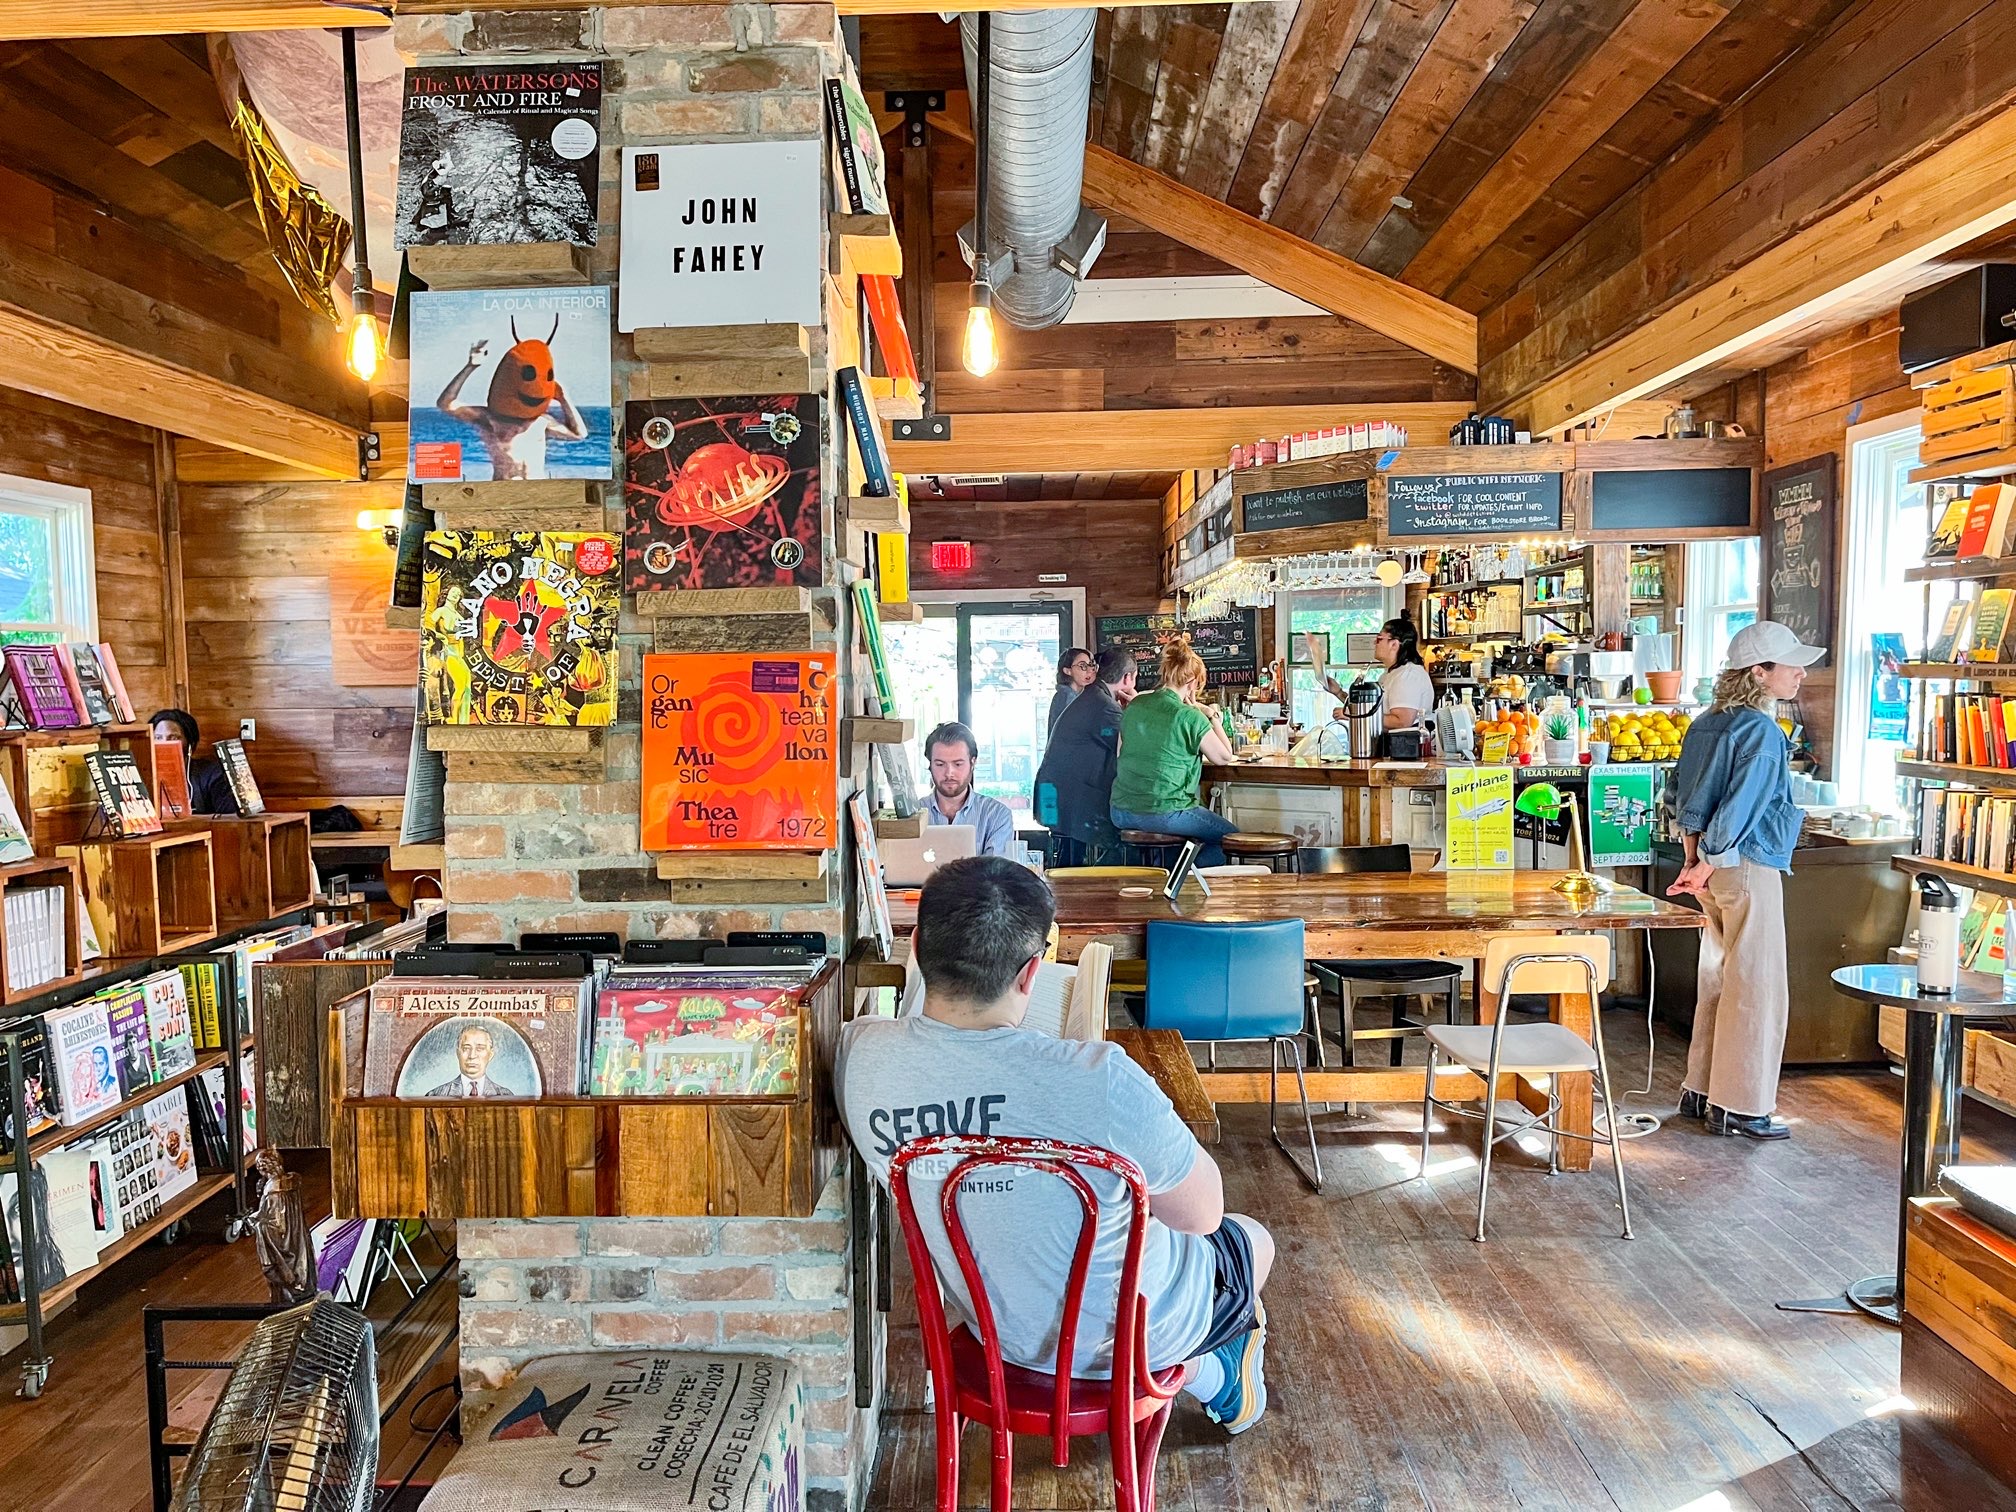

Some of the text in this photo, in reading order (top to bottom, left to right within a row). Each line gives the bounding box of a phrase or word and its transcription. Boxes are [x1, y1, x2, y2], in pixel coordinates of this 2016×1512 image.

[413, 73, 600, 94] The WATERSONS
[408, 92, 563, 110] FROST AND FIRE
[553, 107, 579, 116] Magical
[579, 107, 599, 115] Songs
[835, 100, 848, 141] vulnerables
[843, 147, 853, 167] sigrid
[681, 198, 757, 225] JOHN
[673, 245, 764, 273] FAHEY
[483, 295, 607, 312] LA OLA INTERIOR
[848, 379, 857, 392] THE
[860, 425, 870, 441] MAN
[1444, 477, 1476, 486] PUBLIC
[1477, 476, 1499, 485] WIFI
[1413, 491, 1527, 504] facebook FOR COOL CONTENT
[1414, 502, 1454, 511] twitter
[1457, 503, 1470, 512] FOR
[1525, 502, 1543, 511] INFO
[1413, 516, 1472, 529] Instagram
[1473, 517, 1488, 527] FOR
[1491, 516, 1527, 525] BOOKSTORE
[938, 545, 965, 567] EXIT
[455, 556, 592, 643] MANO NEGRA
[466, 649, 578, 692] BEST OF
[1220, 670, 1255, 684] DRINK!
[651, 674, 679, 694] Or
[808, 671, 828, 691] C
[650, 695, 694, 717] gan
[799, 690, 830, 708] ha
[780, 708, 828, 726] teau
[802, 728, 828, 743] va
[673, 747, 715, 767] Mu
[784, 742, 829, 761] llon
[1522, 769, 1582, 777] TEXAS THEATRE
[1616, 766, 1652, 774] THEATRE
[1451, 773, 1509, 795] airplane
[676, 801, 739, 821] Thea
[708, 821, 738, 838] tre
[776, 818, 827, 838] 1972
[1593, 856, 1614, 864] SEPT
[1628, 854, 1650, 862] 2024
[153, 981, 175, 1004] CUE
[168, 997, 187, 1019] THE
[408, 996, 540, 1012] Alexis Zoumbas
[61, 1013, 95, 1036] COCAINE
[158, 1017, 186, 1042] SUN!
[63, 1022, 108, 1049] RHINESTONES
[643, 1358, 672, 1395] COFFEE
[557, 1356, 649, 1489] CARAVELA
[636, 1375, 699, 1471] CLEAN COFFEE
[707, 1360, 773, 1512] CAFÉ DE EL SALVADOR
